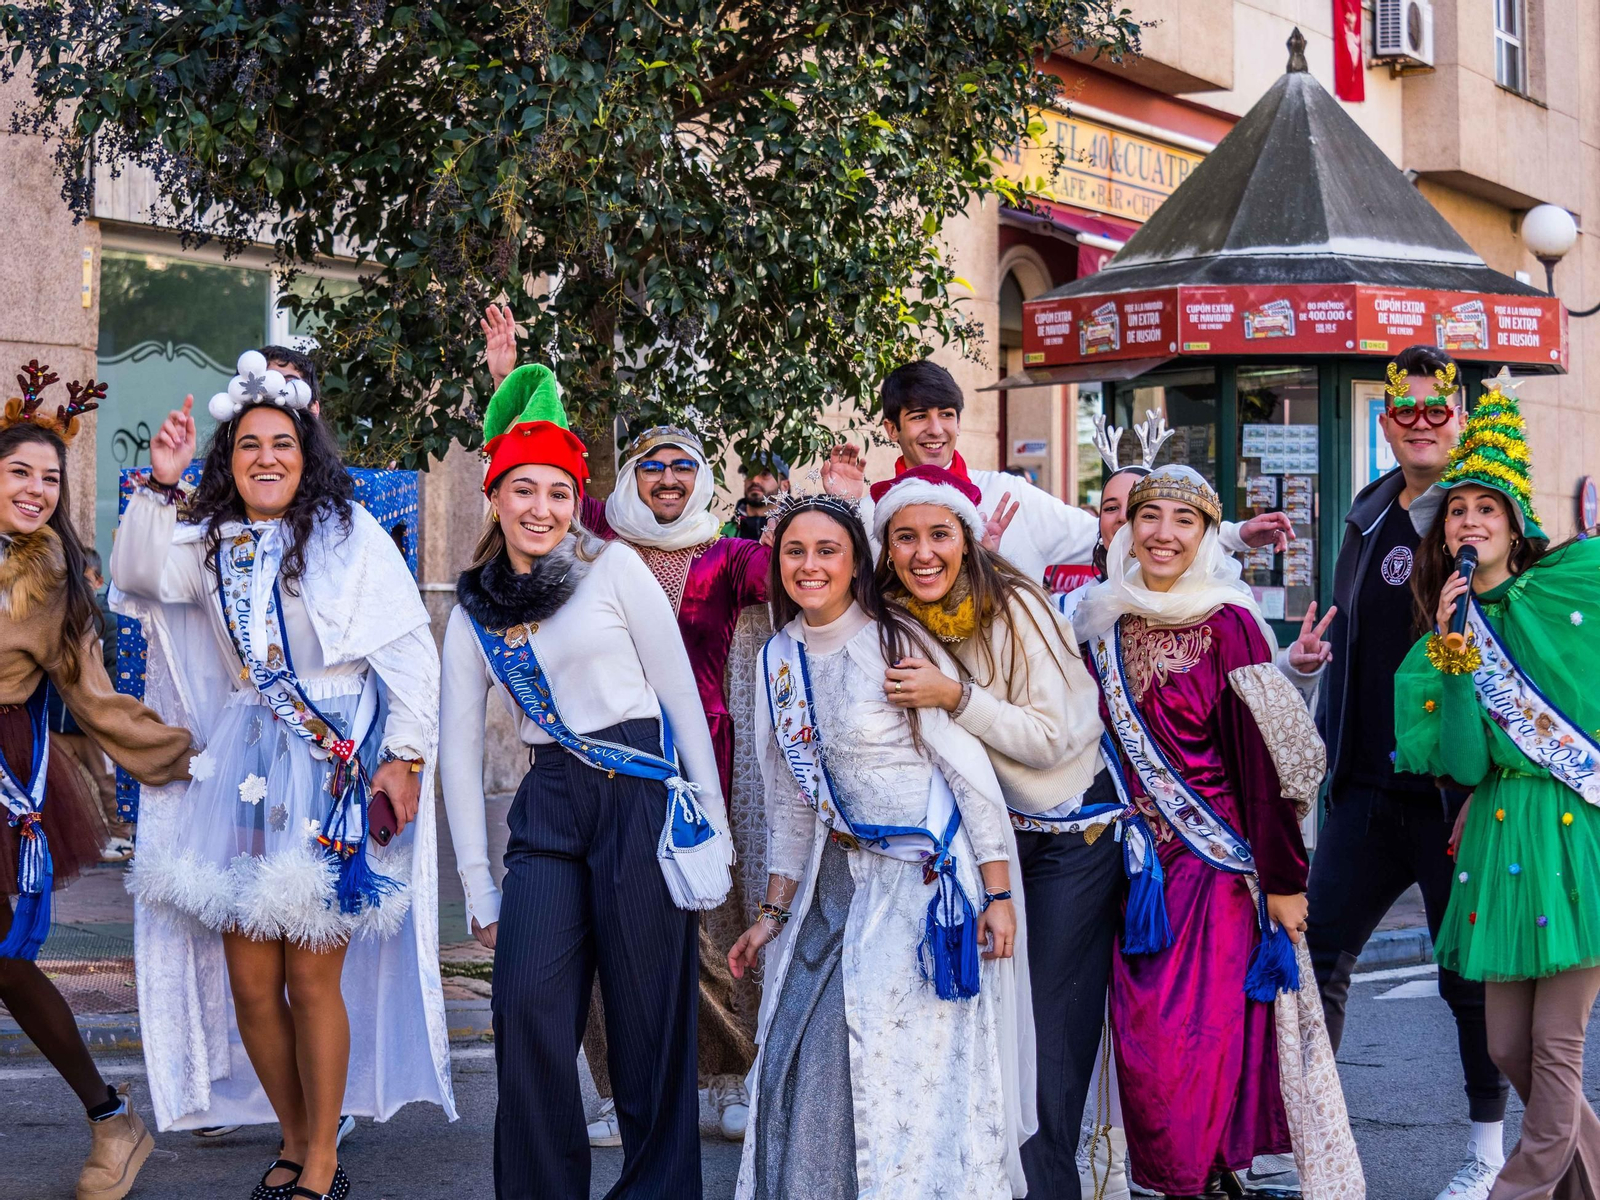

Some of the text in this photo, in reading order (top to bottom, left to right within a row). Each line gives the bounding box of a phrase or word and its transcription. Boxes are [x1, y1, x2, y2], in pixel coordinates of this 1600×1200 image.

[1056, 121, 1201, 187] EL 40&CUATR
[1098, 184, 1124, 211] BAR
[1186, 302, 1235, 314] CUPÓN EXTRA
[1307, 301, 1345, 310] 80 PREMIOS
[1375, 298, 1426, 313] CUPÓN EXTRA
[1519, 307, 1542, 317] NAVIDAD
[1128, 313, 1138, 327] UN
[1138, 312, 1160, 326] EXTRA
[1189, 313, 1232, 323] DE NAVIDAD
[1299, 310, 1353, 321] DE 400.000 €
[1378, 312, 1423, 326] DE NAVIDAD
[1499, 316, 1538, 331] UN EXTRA
[1126, 330, 1136, 344] DE
[1136, 326, 1162, 344] ILUSIÓN
[1397, 327, 1414, 336] ENERO
[1497, 331, 1540, 347] DE ILUSIÓN
[503, 660, 545, 716] Salinera
[1473, 671, 1594, 781] Salinera 2024
[1112, 711, 1165, 788] Salinera
[783, 733, 818, 812] Saliner
